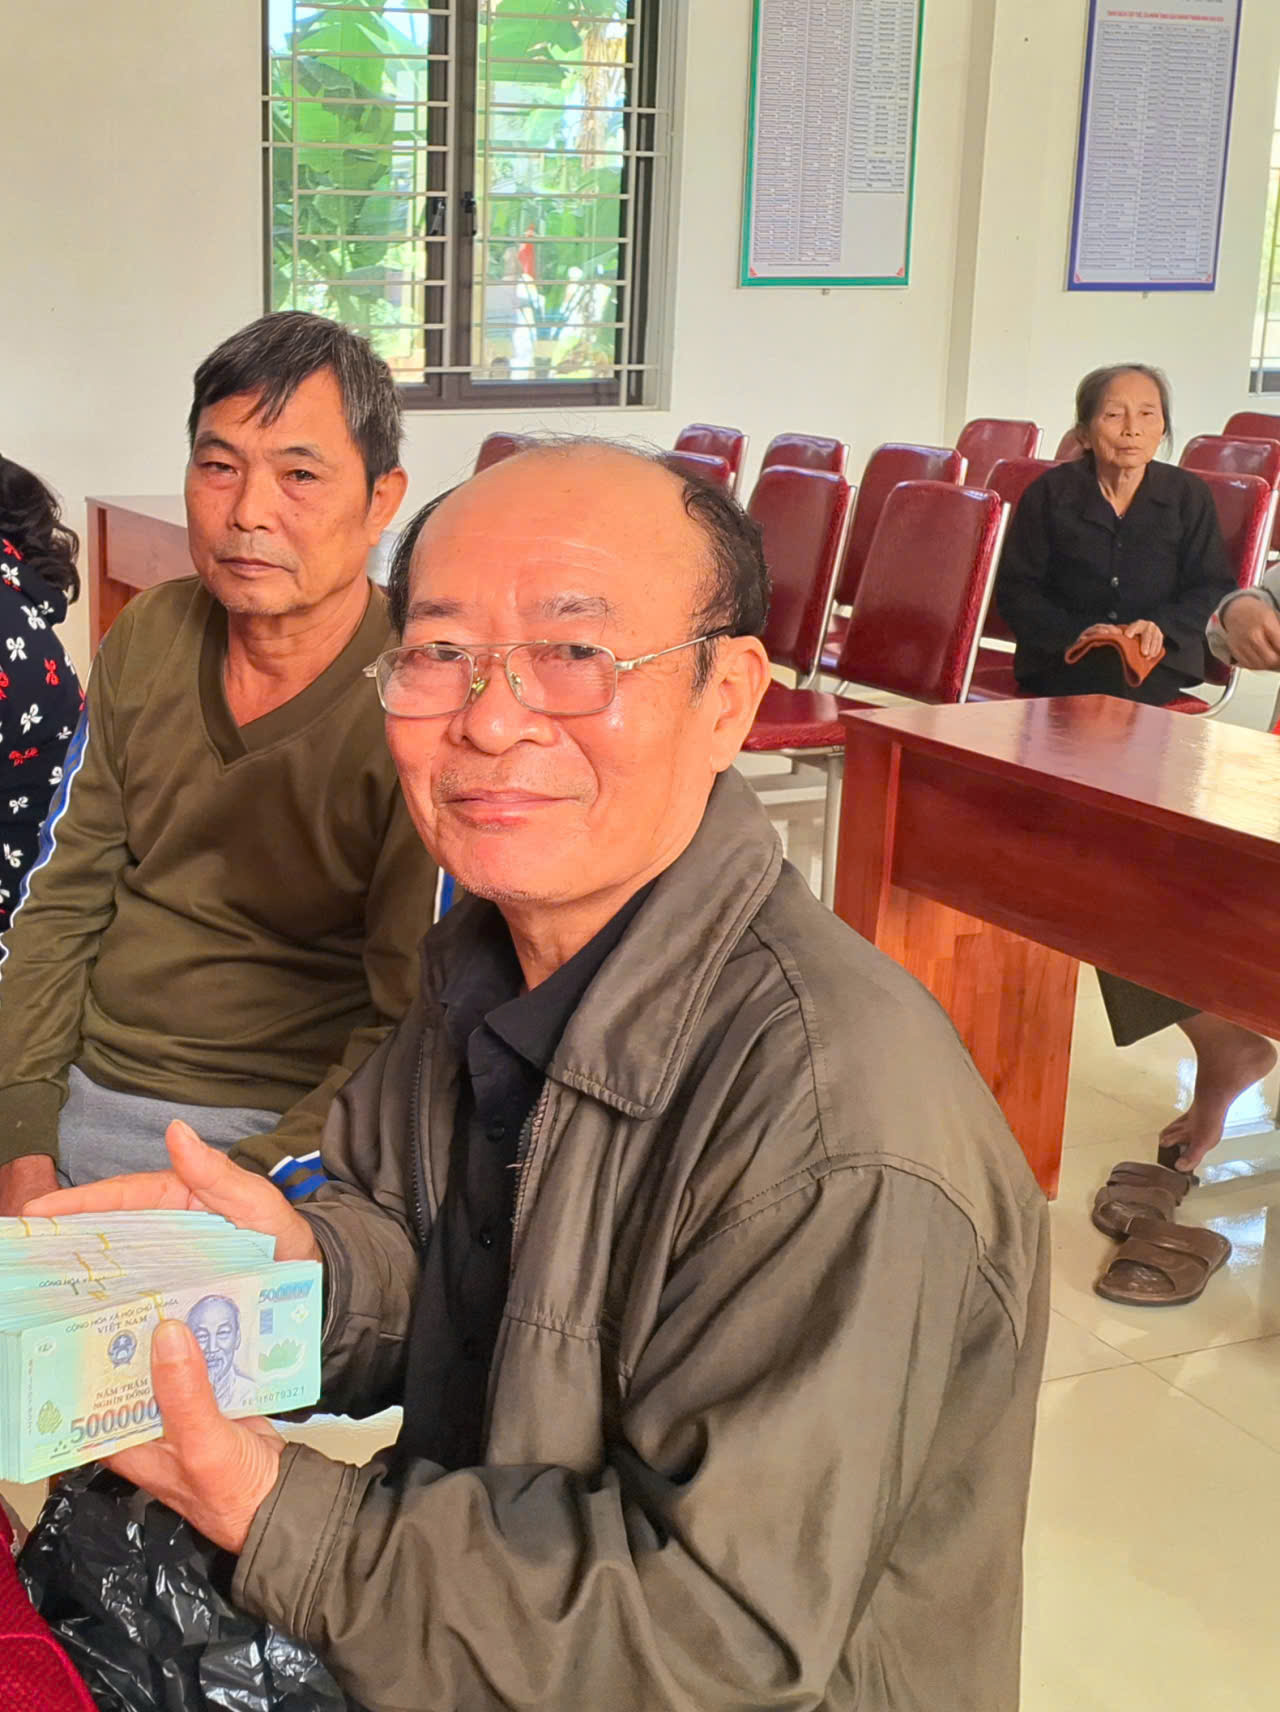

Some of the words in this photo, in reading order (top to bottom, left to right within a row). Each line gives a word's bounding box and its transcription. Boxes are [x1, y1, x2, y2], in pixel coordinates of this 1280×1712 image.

[124, 1315, 149, 1327] NAM
[96, 1387, 119, 1400] NĂM
[70, 1395, 160, 1443] 500000
